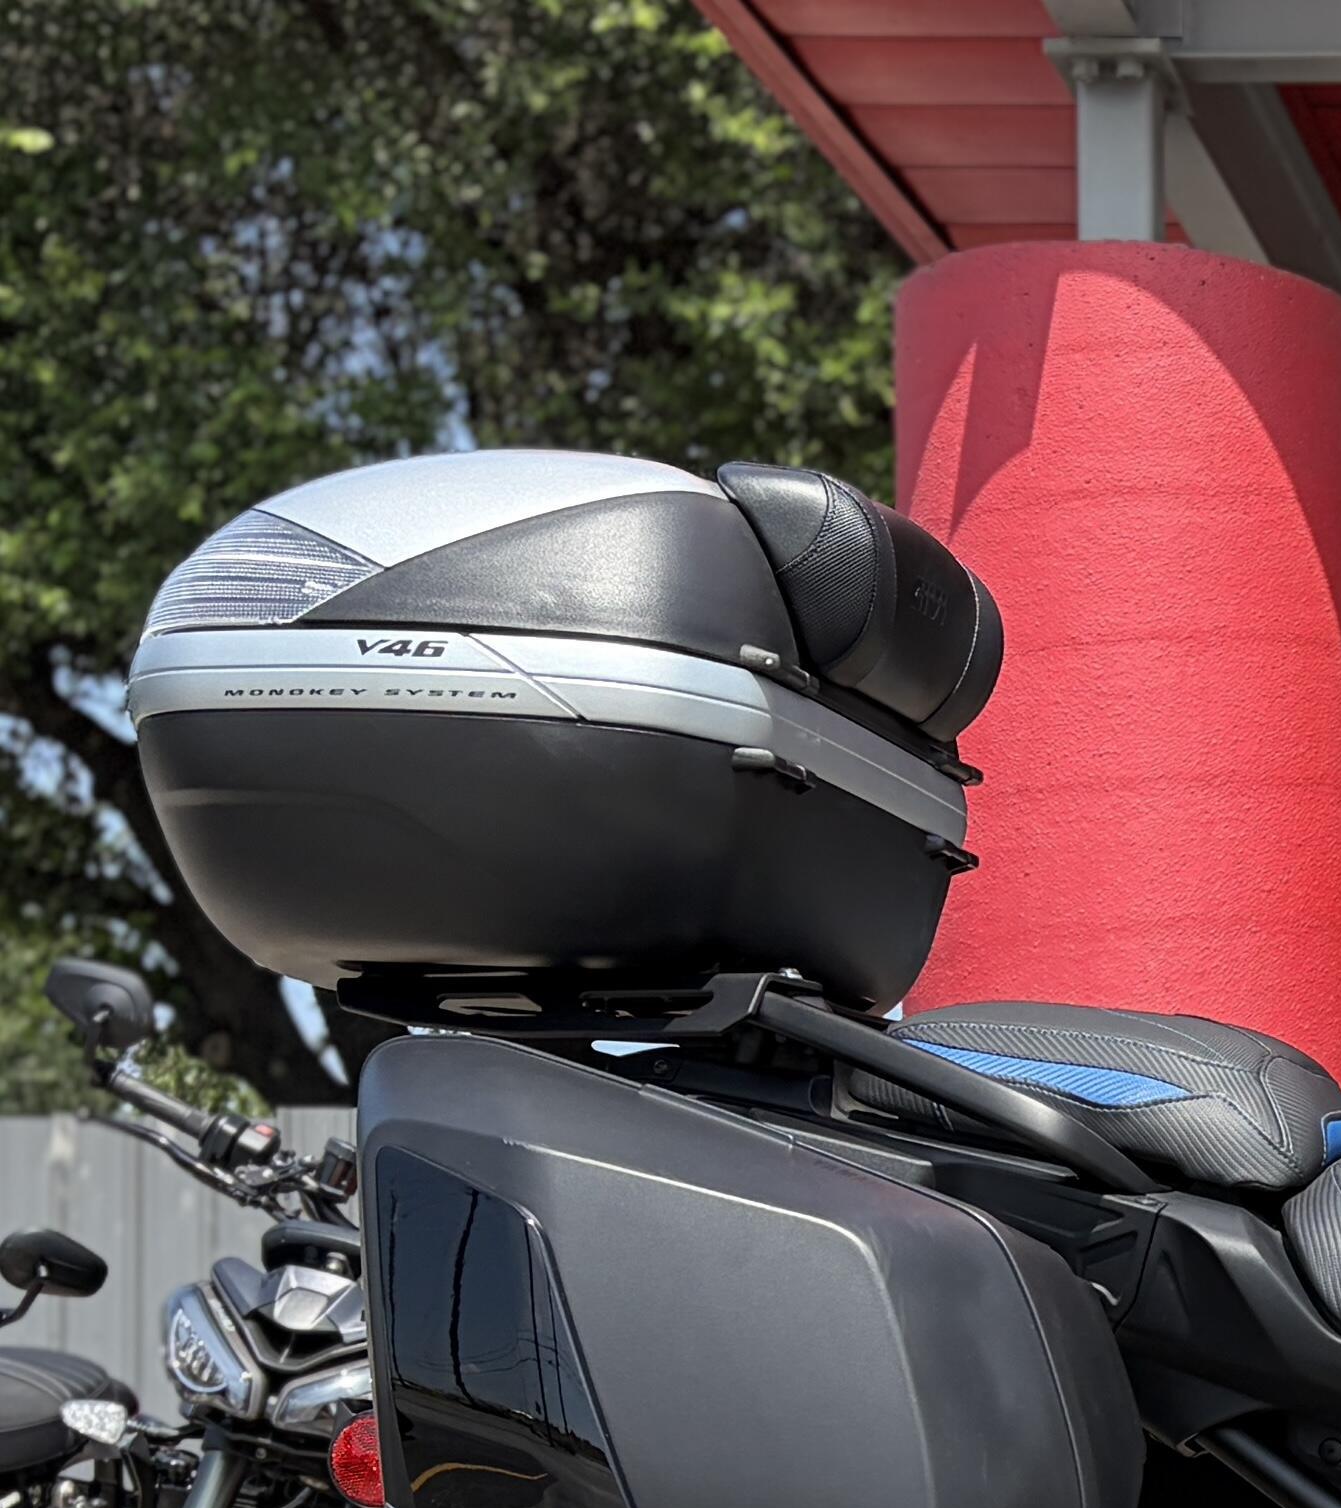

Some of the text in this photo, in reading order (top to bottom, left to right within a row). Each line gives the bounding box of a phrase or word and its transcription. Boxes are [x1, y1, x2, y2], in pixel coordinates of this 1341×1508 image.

[357, 639, 448, 657] V46
[225, 688, 517, 699] MONOKEY SYSTEM
